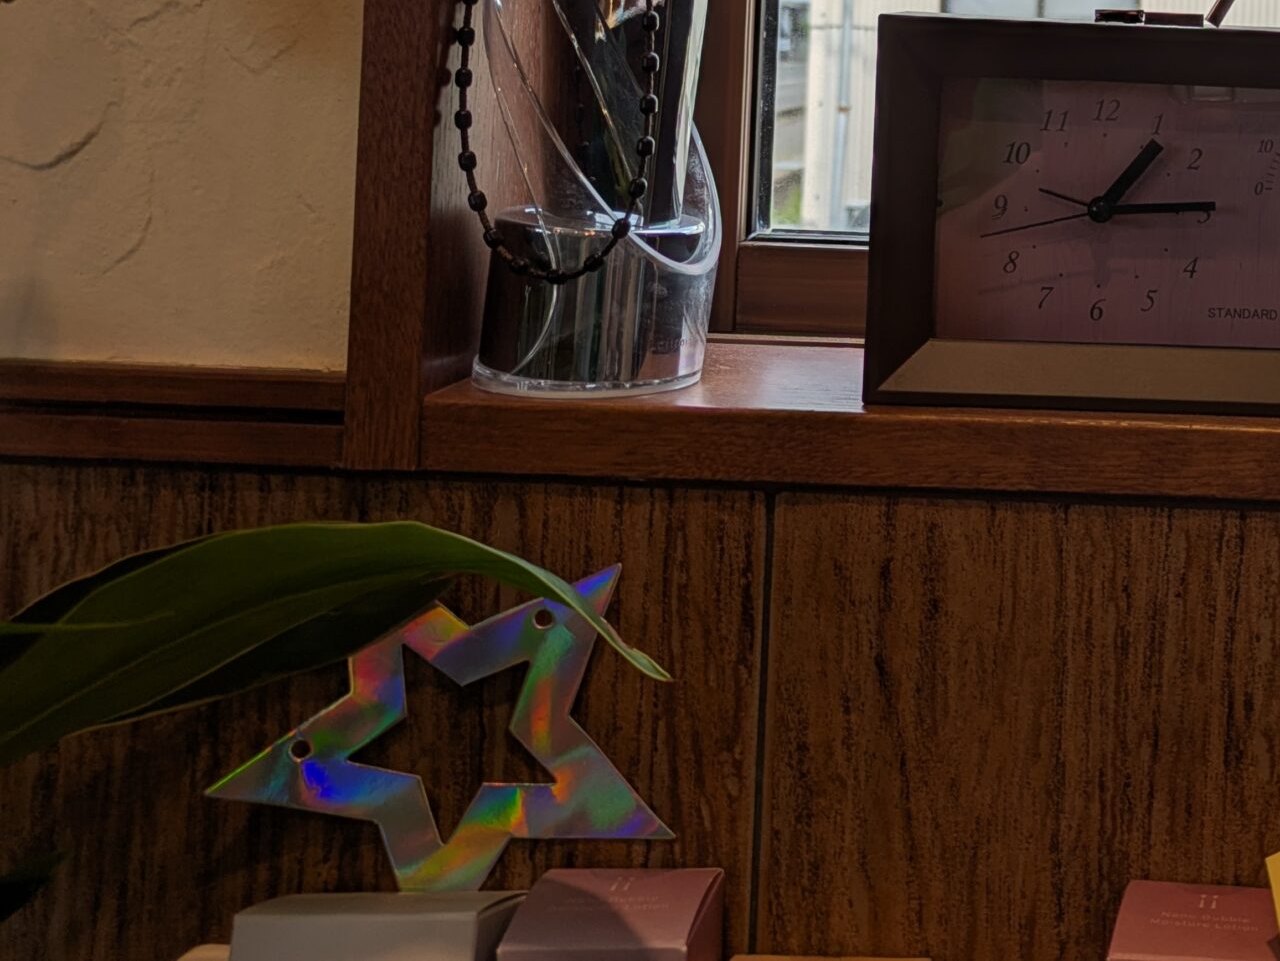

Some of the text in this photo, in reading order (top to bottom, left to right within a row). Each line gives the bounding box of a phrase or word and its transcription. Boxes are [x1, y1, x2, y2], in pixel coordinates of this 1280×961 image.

[1040, 109, 1069, 133] 11
[1093, 99, 1121, 121] 12
[1151, 113, 1164, 136] 1
[1003, 141, 1031, 165] 10
[1258, 140, 1274, 153] 10
[1187, 148, 1203, 170] 2
[1254, 183, 1264, 195] 0
[991, 195, 1008, 220] 9
[1003, 250, 1020, 274] 8
[1183, 257, 1199, 279] 4
[1038, 287, 1055, 310] 7
[1140, 290, 1158, 312] 5
[1089, 299, 1106, 322] 6
[1208, 307, 1278, 320] STANDARD
